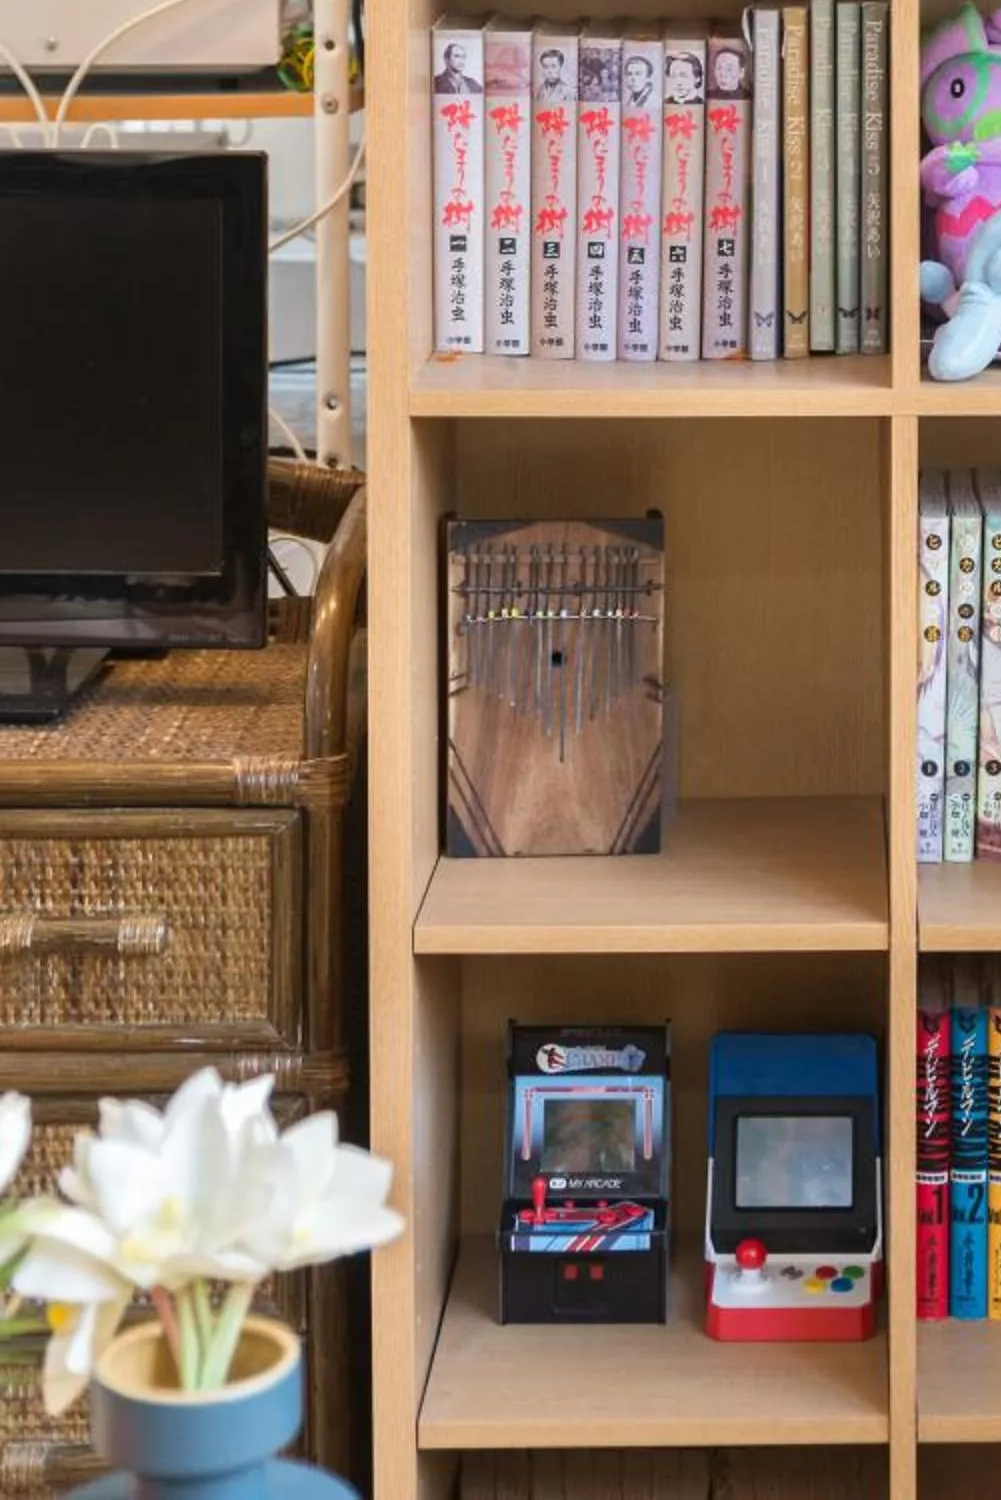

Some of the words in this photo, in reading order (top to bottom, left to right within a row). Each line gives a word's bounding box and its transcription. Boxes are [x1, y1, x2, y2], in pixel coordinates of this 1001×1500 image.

[786, 24, 805, 105] Paradise
[864, 20, 883, 101] Paradise
[786, 116, 805, 157] Kiss
[864, 112, 883, 151] Kiss
[543, 241, 560, 258] 三
[717, 238, 735, 256] 七
[451, 257, 466, 322] 手塚治虫
[499, 260, 516, 325] 手塚治虫
[543, 263, 559, 329] 手塚治虫
[588, 265, 603, 330] 手塚治虫
[628, 270, 644, 334] 手塚治虫
[669, 268, 685, 331] 手塚治虫
[717, 263, 733, 327] 手塚治虫
[924, 1033, 940, 1138] デビルマン
[960, 1032, 976, 1137] デビルマン
[568, 1178, 583, 1189] MY
[585, 1178, 623, 1189] ARCADE
